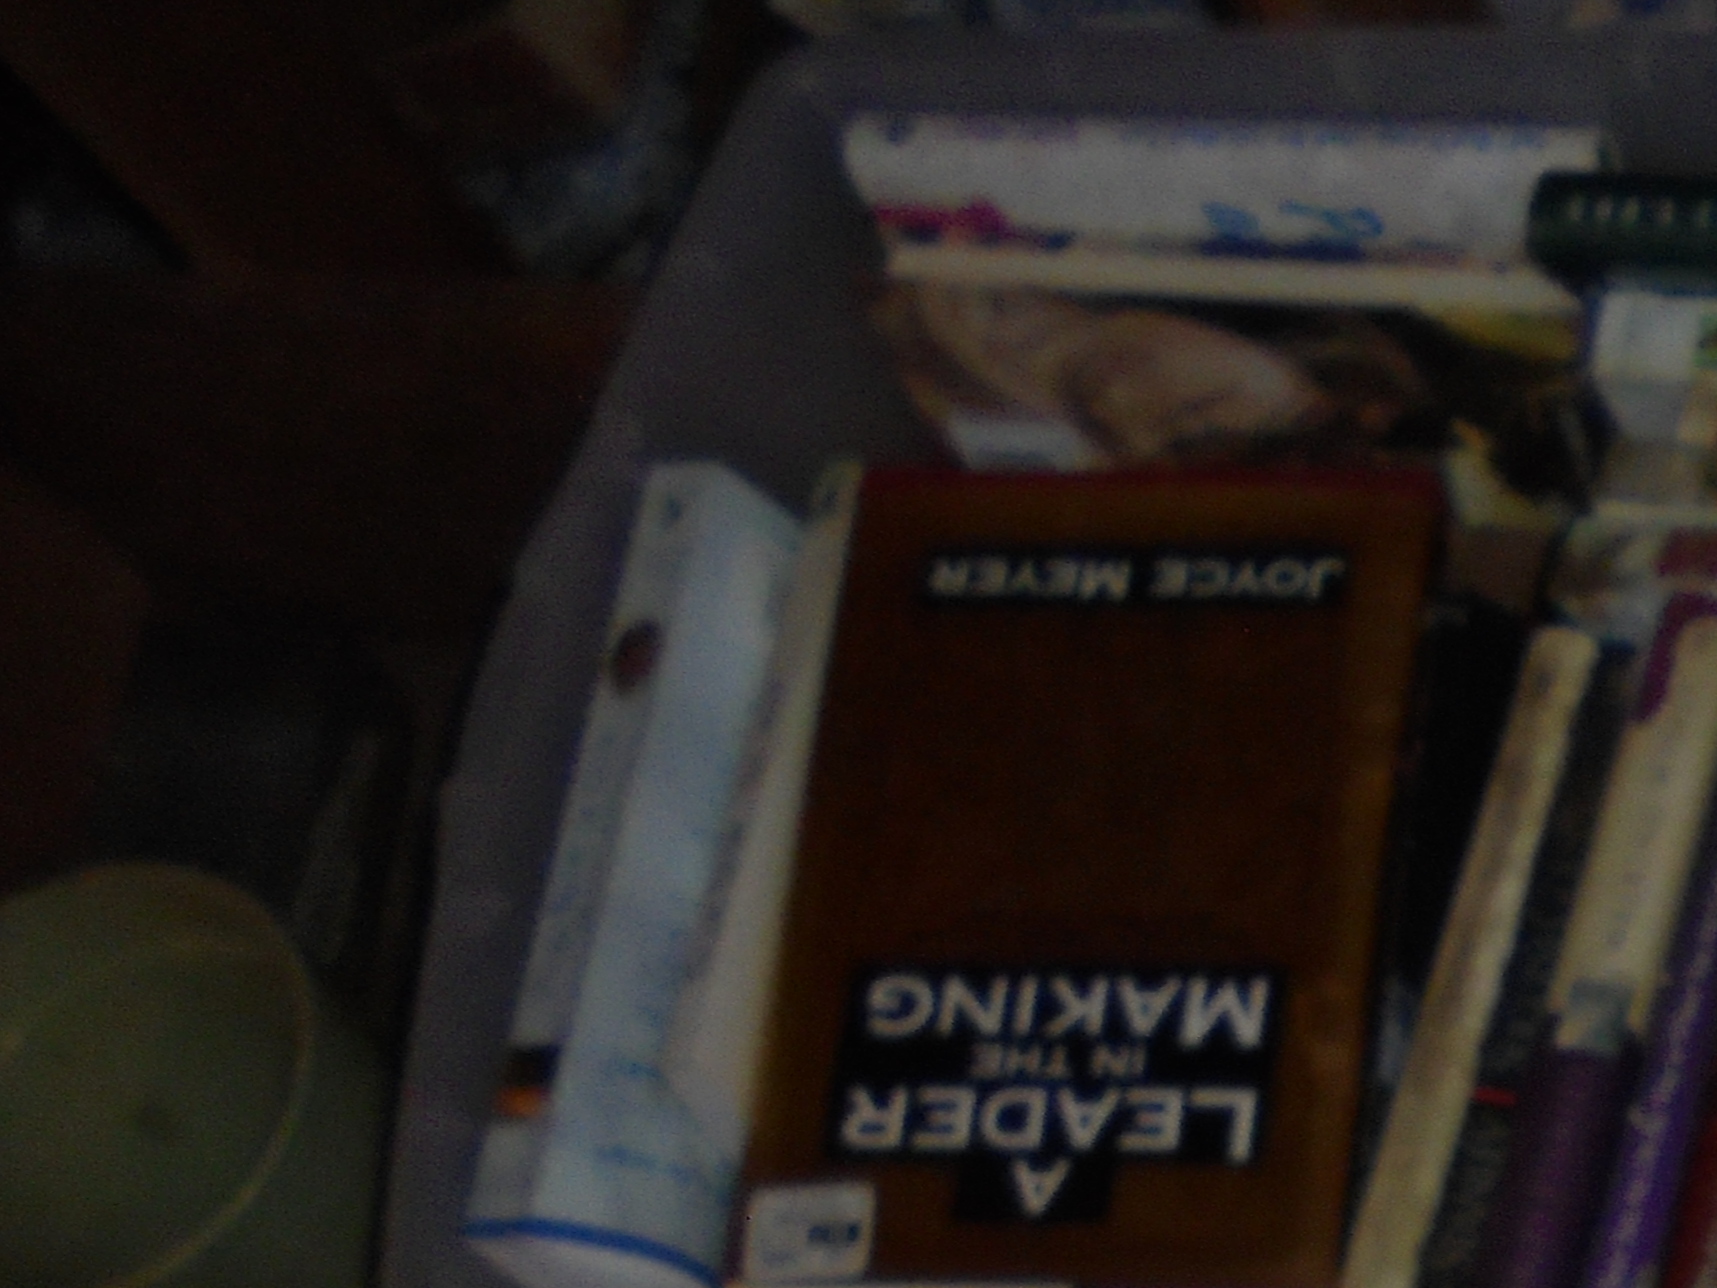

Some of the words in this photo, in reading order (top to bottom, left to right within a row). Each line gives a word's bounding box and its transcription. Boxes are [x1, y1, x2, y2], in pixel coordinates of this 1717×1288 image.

[930, 553, 1131, 602] MEYER
[1154, 555, 1345, 600] JOYCE
[863, 973, 1277, 1051] MAKING
[969, 1043, 1073, 1079] THE
[1088, 1048, 1147, 1079] IN
[840, 1084, 1260, 1166] LEADER
[1007, 1156, 1073, 1220] A
